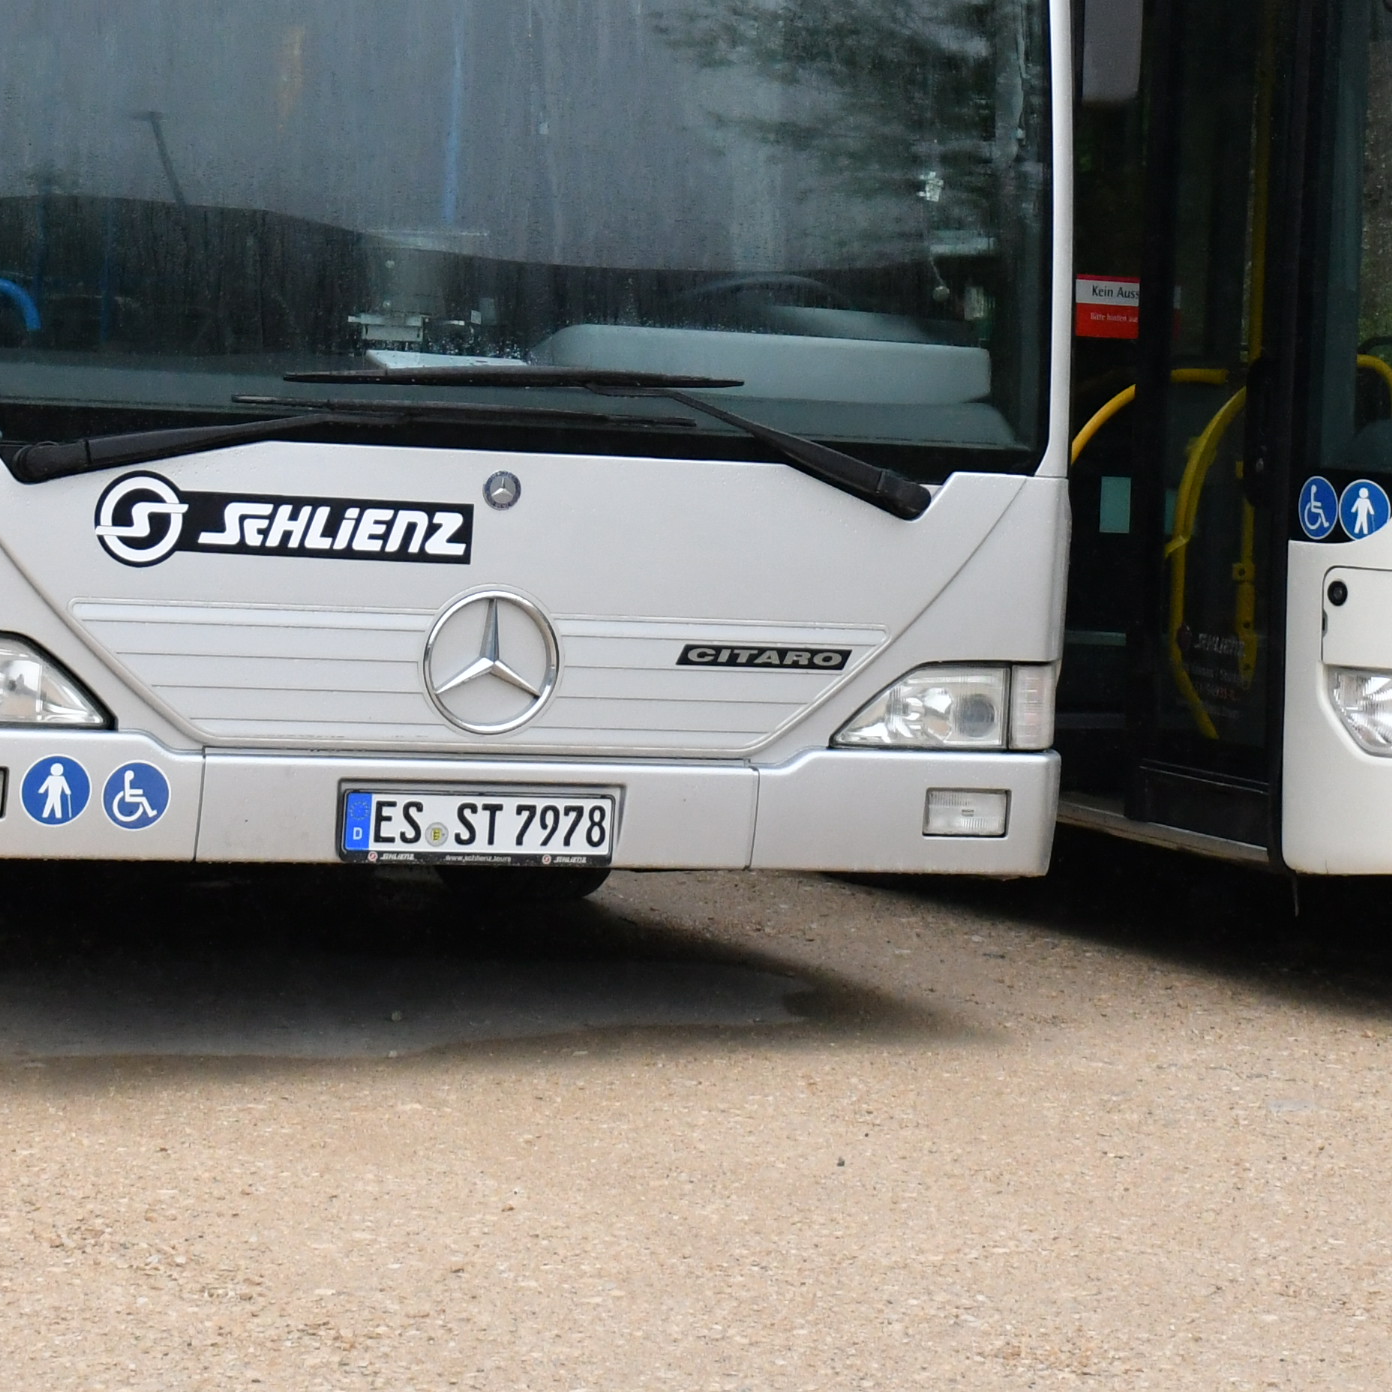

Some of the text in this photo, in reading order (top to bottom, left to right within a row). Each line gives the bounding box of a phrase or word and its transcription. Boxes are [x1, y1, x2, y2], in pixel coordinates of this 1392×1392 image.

[1091, 284, 1114, 298] Kein
[686, 647, 844, 668] CITARO
[352, 799, 607, 849] D ES ST 7978
